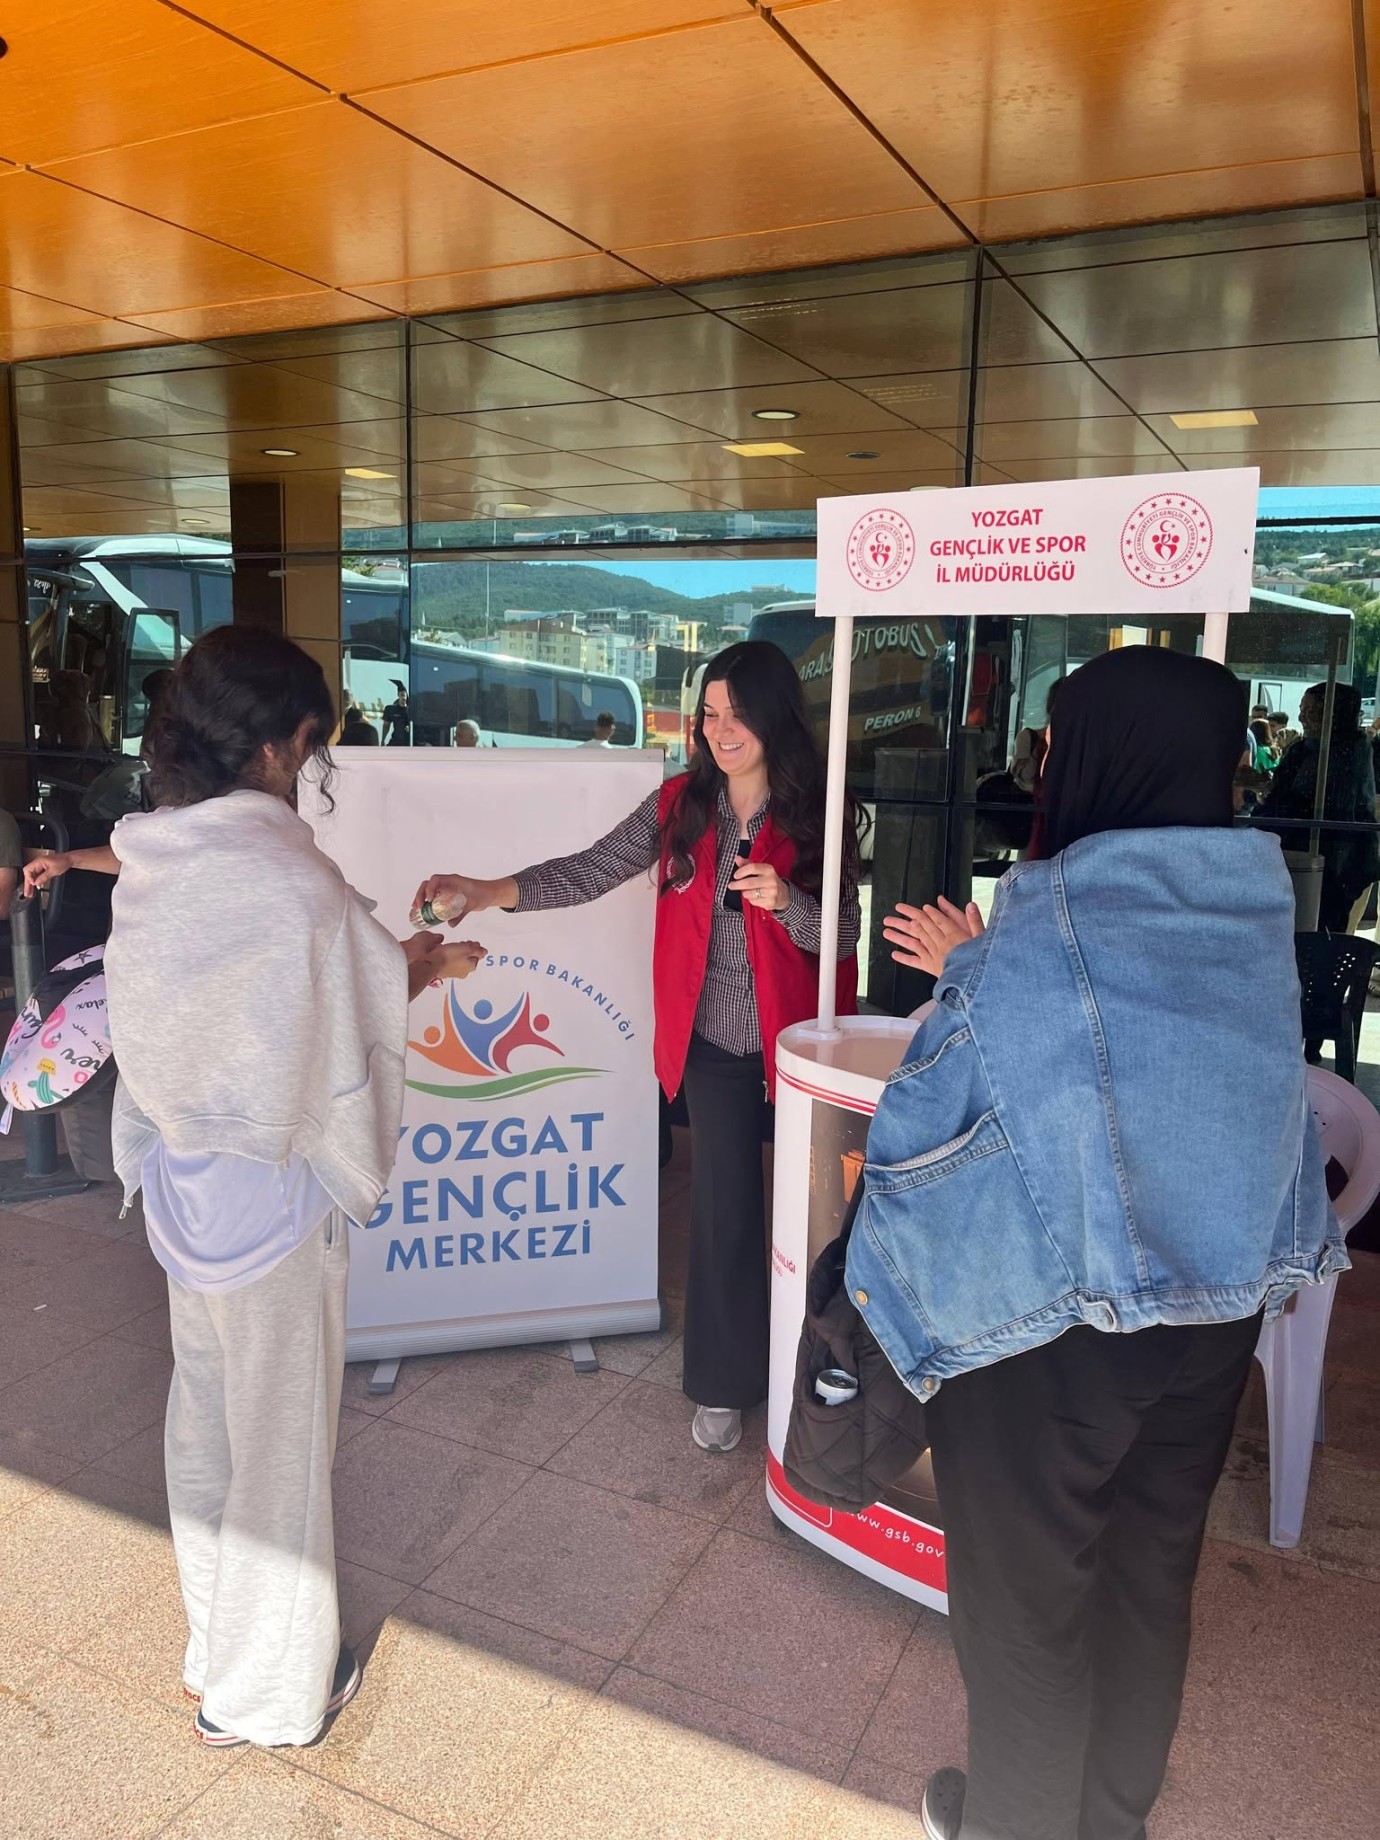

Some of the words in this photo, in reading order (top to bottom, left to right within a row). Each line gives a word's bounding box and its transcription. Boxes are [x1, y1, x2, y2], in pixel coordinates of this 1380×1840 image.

[971, 508, 1043, 528] YOZGAT
[929, 535, 1004, 560] GENÇLİK
[1008, 537, 1031, 554] VE
[1035, 535, 1087, 553] SPOR
[936, 564, 951, 582] İL
[955, 560, 1075, 582] MÜDÜRLÜĞÜ
[864, 709, 913, 731] PERON
[75, 997, 109, 1015] elax
[486, 955, 539, 971] SPOR
[546, 964, 635, 1041] BAKANLIĞI
[398, 1112, 604, 1164] OZGAT
[385, 1218, 591, 1273] MERKEZİ
[846, 1511, 944, 1558] ww.gsb.gov
